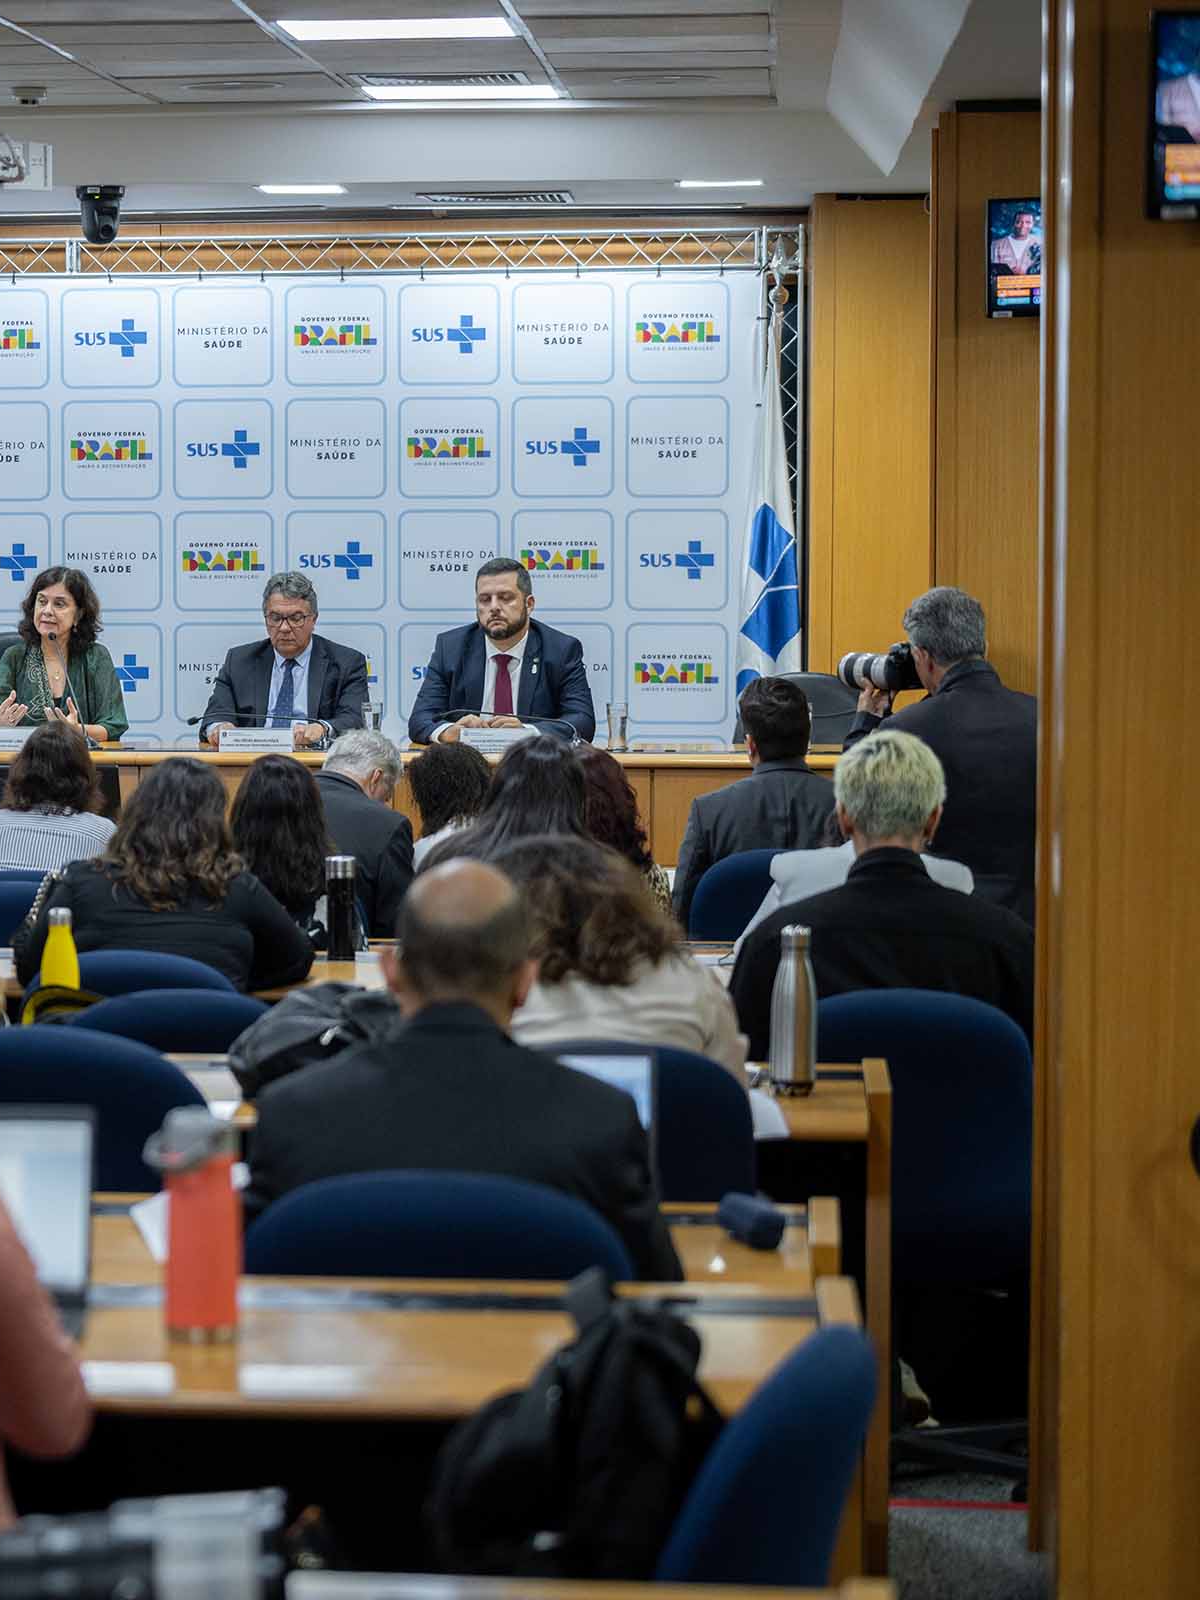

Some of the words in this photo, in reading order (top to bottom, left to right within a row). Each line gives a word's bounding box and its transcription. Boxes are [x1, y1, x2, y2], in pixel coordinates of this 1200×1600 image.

[252, 327, 269, 337] DA
[593, 323, 610, 333] DA
[636, 322, 720, 342] BRASIL
[75, 332, 104, 346] SUS
[294, 325, 377, 346] BRASIL
[412, 328, 443, 342] SUS
[543, 335, 583, 346] SAÚDE
[202, 339, 242, 350] SAÚDE
[29, 441, 46, 451] DA
[365, 438, 382, 448] DA
[707, 436, 724, 446] DA
[71, 440, 152, 460] BRASIL
[187, 443, 217, 457] SUS
[407, 437, 491, 457] BRASIL
[527, 440, 558, 454] SUS
[316, 450, 356, 461] SAÚDE
[657, 448, 697, 459] SAÚDE
[142, 551, 159, 561] DA
[183, 550, 265, 570] BRASIL
[478, 550, 495, 560] DA
[521, 549, 604, 569] BRASIL
[640, 553, 671, 567] SUS
[300, 555, 330, 569] SUS
[428, 562, 468, 573] SAÚDE
[92, 563, 132, 574] SAÚDE
[178, 663, 220, 672] MINIST
[593, 663, 608, 672] DA
[635, 663, 719, 683] BRASIL
